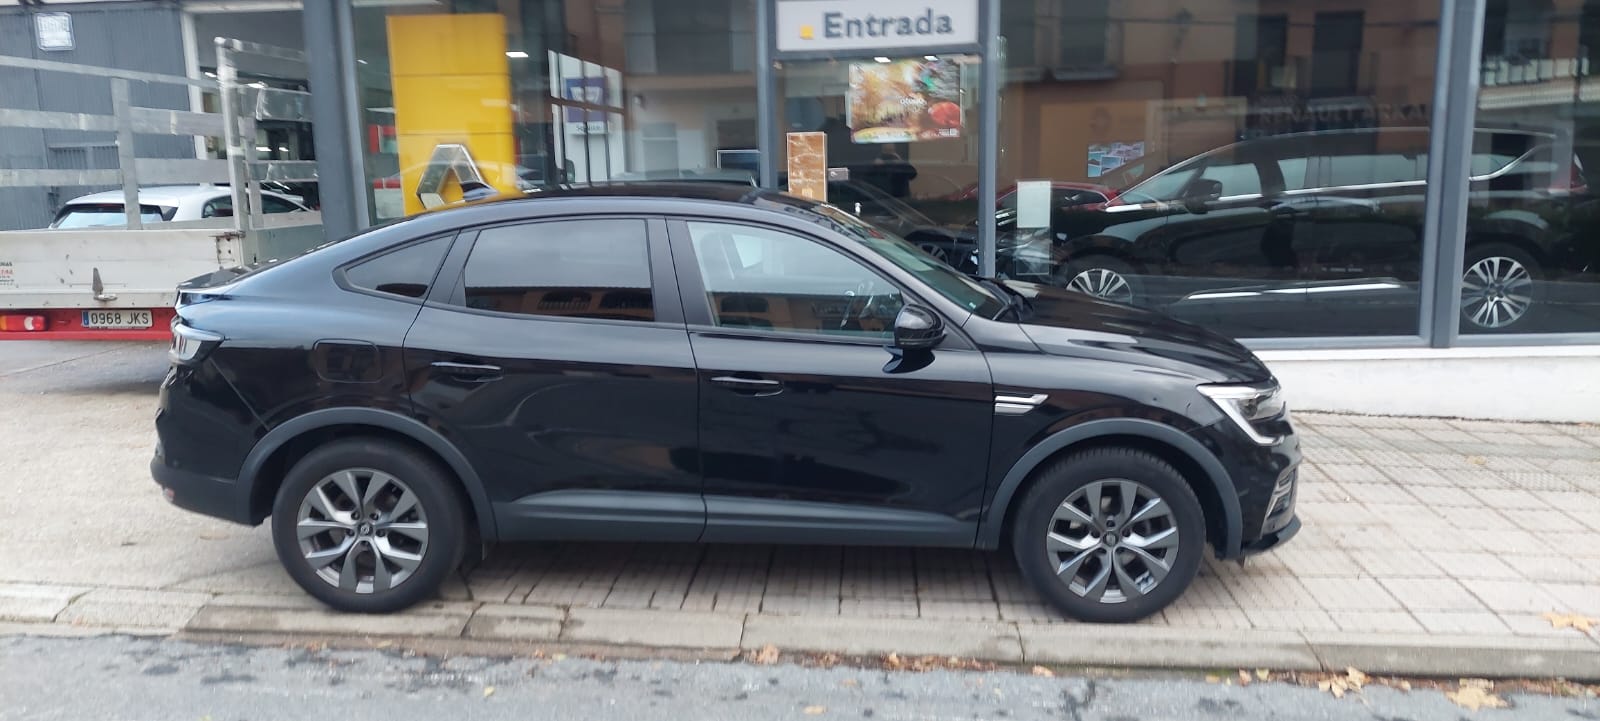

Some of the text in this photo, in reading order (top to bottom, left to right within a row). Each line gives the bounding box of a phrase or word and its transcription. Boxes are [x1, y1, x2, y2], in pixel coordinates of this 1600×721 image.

[824, 8, 954, 38] Entrada
[91, 312, 149, 325] 0968 JKS
